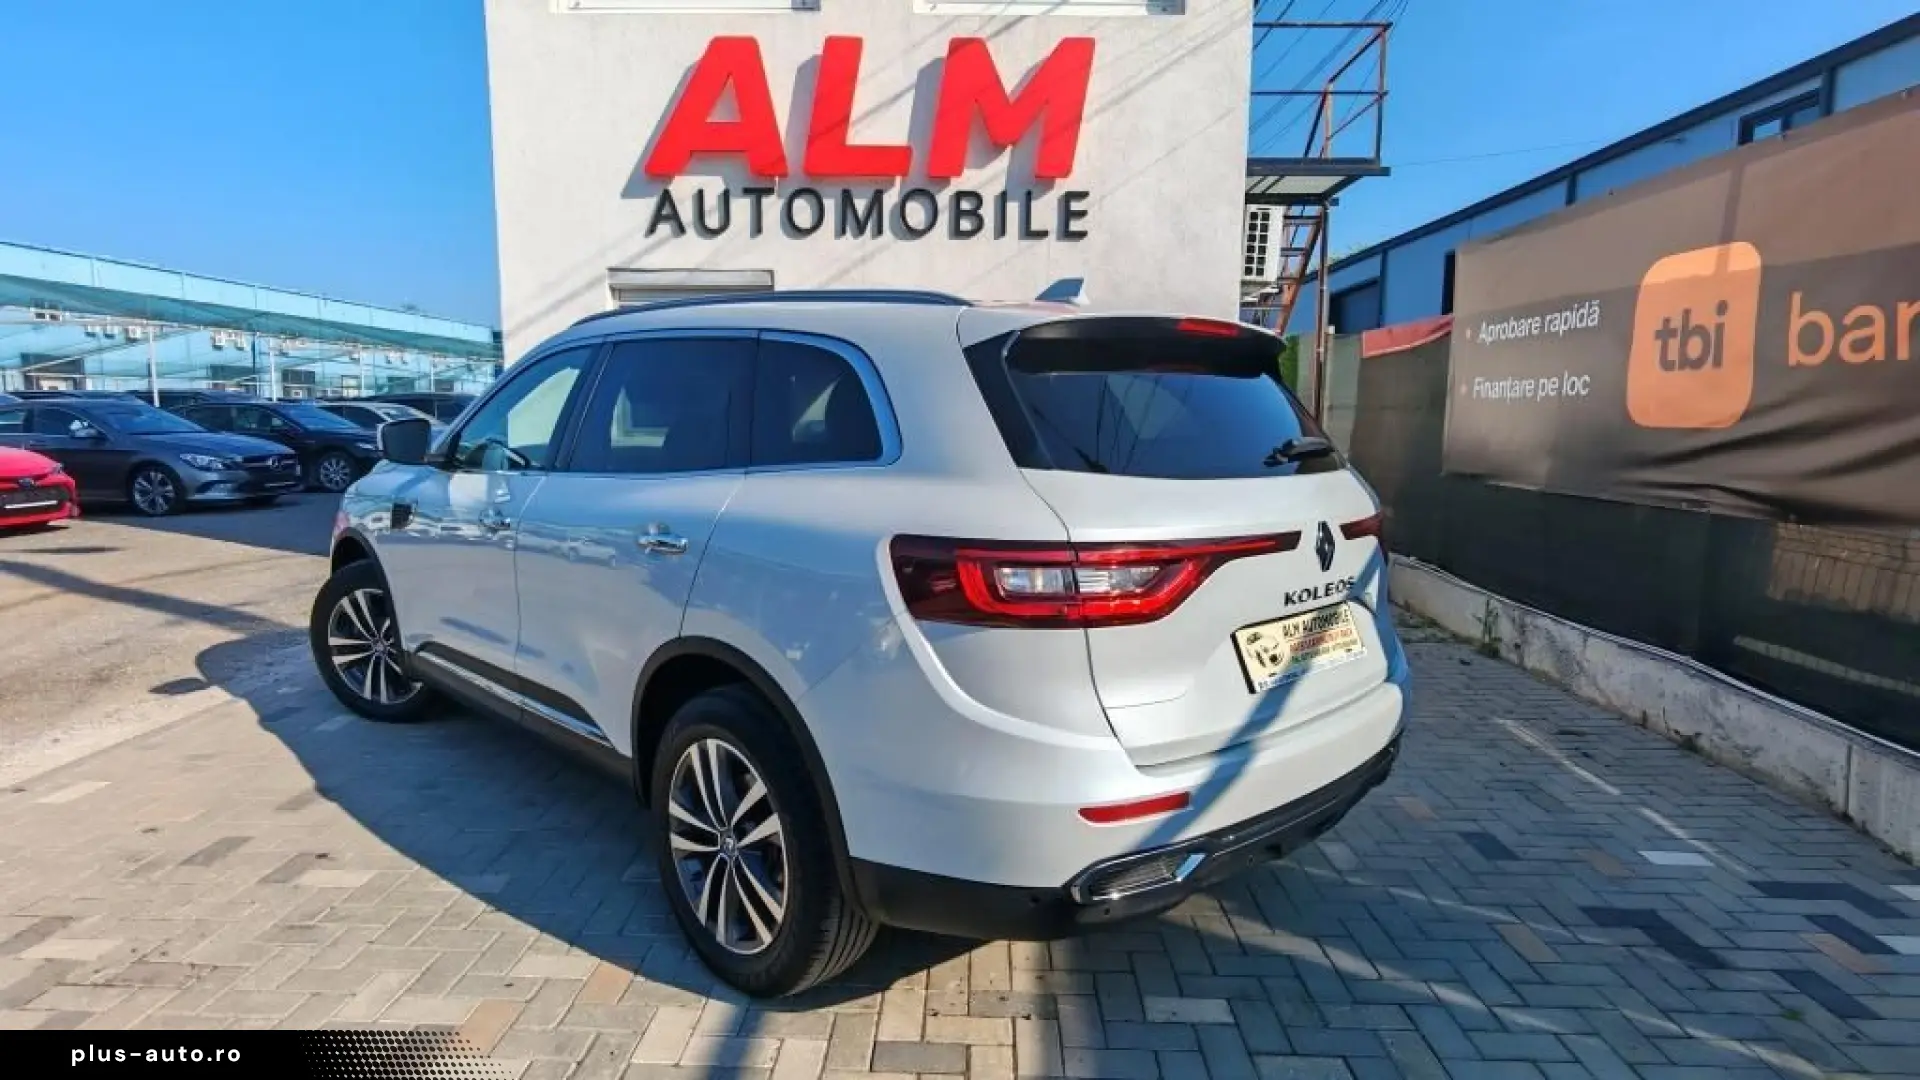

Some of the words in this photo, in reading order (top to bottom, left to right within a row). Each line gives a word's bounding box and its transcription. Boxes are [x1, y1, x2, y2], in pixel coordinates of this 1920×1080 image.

[644, 36, 1096, 179] ALM
[645, 188, 1090, 240] AUTOMOBILE
[1478, 315, 1541, 346] Aprobare
[1544, 299, 1600, 337] rapidă
[1654, 299, 1729, 373] tbi
[1536, 376, 1559, 402] pe
[1561, 369, 1591, 397] loc
[1283, 576, 1355, 607] KOLEOS
